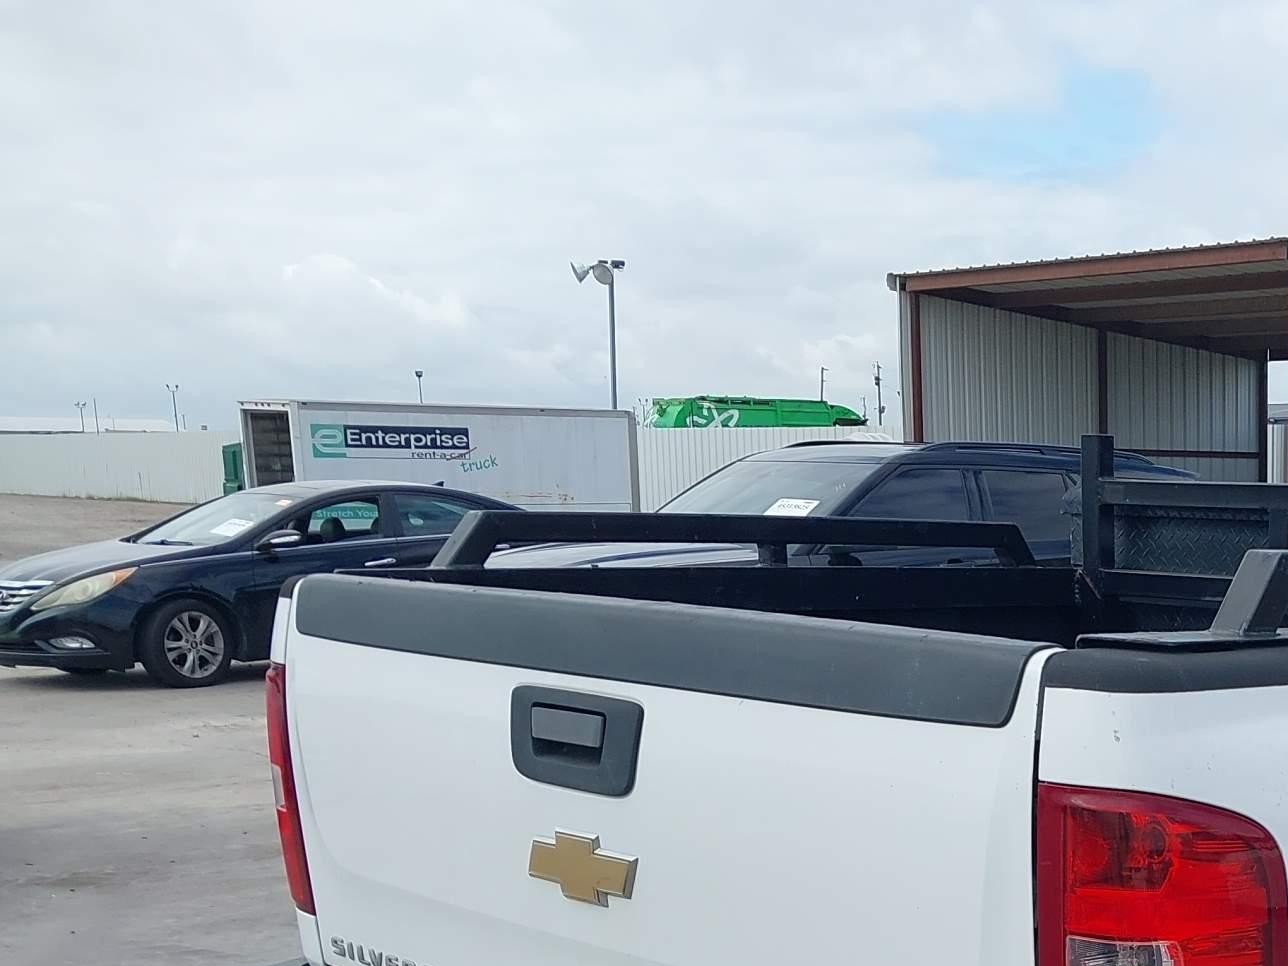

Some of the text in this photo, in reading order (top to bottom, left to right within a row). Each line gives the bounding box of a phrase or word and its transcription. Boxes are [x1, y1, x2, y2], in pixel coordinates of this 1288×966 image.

[346, 428, 469, 450] Enterprise
[411, 450, 470, 460] rent-a-car
[461, 455, 499, 473] truck
